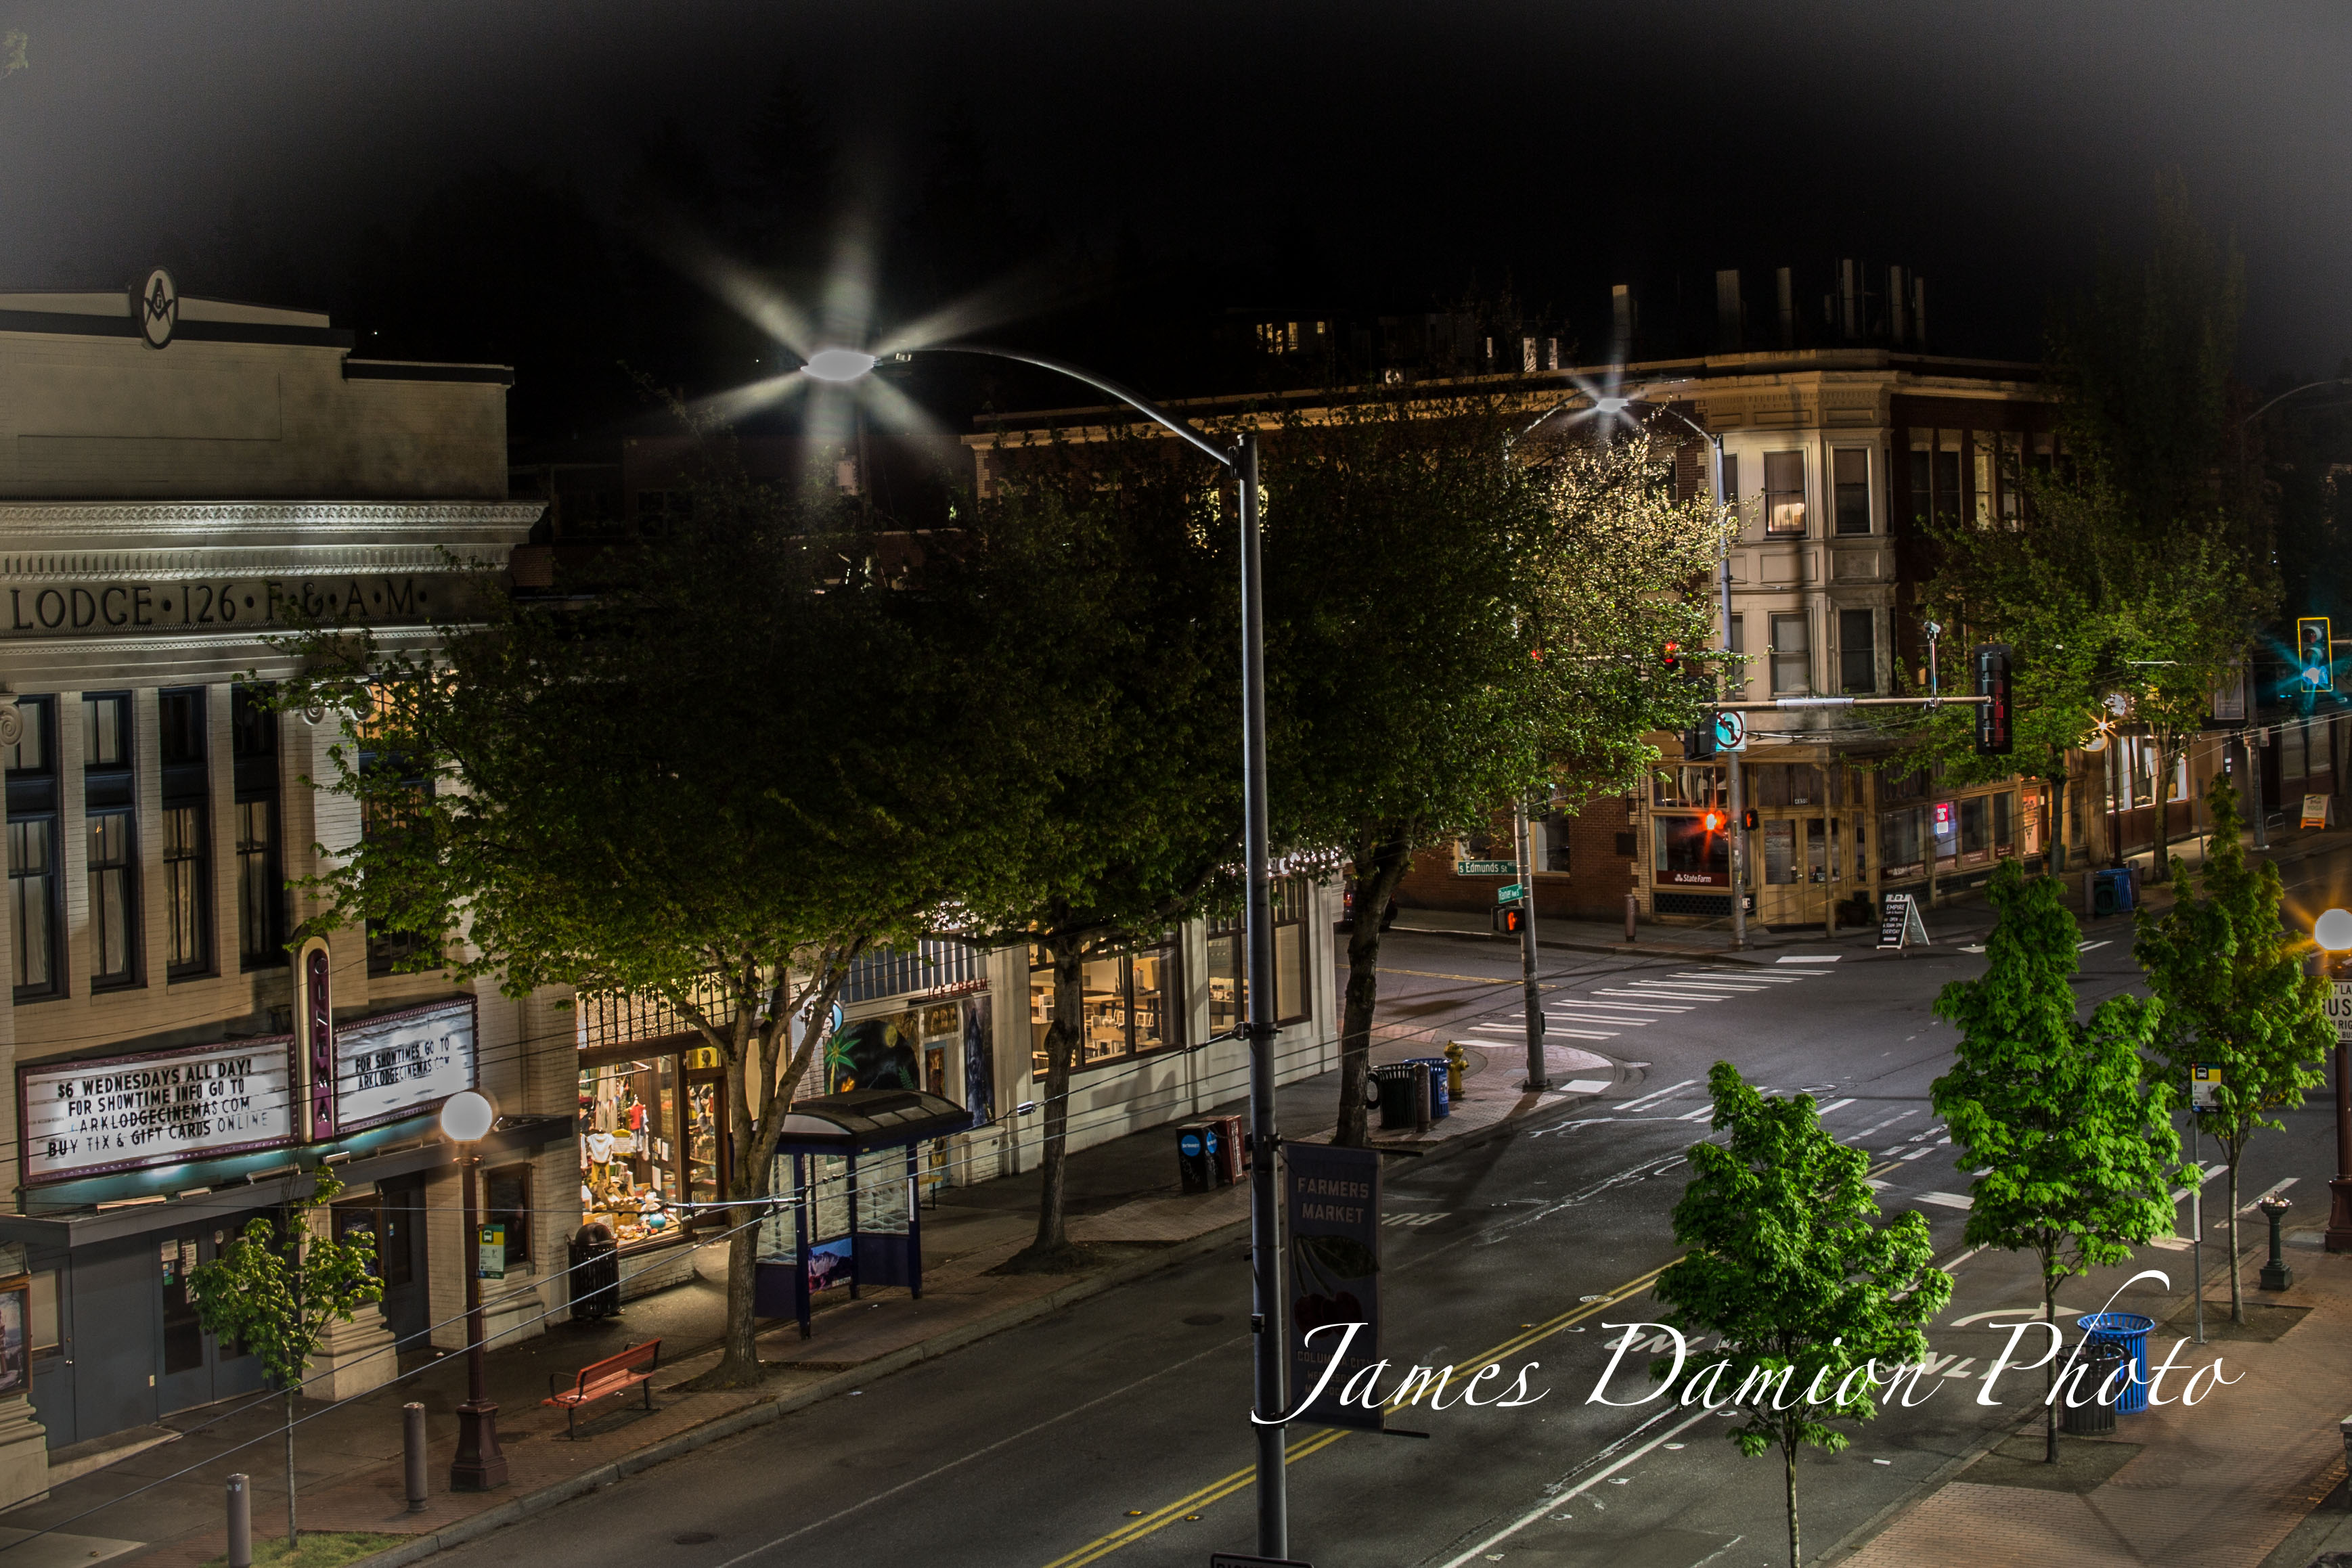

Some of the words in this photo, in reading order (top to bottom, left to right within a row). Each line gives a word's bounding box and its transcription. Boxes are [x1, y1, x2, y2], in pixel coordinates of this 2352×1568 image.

[10, 586, 152, 630] LODGE
[181, 584, 236, 624] 126
[1465, 862, 1499, 873] Edmunds
[928, 985, 946, 999] ICE
[950, 977, 988, 996] CREAM
[355, 1056, 372, 1073] FOR
[376, 1044, 420, 1068] SHOWTIMES
[425, 1041, 434, 1055] GO
[440, 1037, 449, 1052] TO
[58, 1082, 74, 1098] $6
[83, 1068, 180, 1096] WEDNESDAYS
[186, 1065, 212, 1082] ALL
[218, 1058, 252, 1077] DAY!
[68, 1100, 92, 1117] FOR
[98, 1088, 170, 1112] SHOWTIME
[176, 1084, 202, 1102] INFO
[209, 1081, 224, 1097] GO
[231, 1078, 244, 1094] TO
[48, 1139, 78, 1158] BUY
[87, 1135, 110, 1151] TIX
[116, 1134, 125, 1148] &
[131, 1126, 162, 1145] GIFT
[169, 1120, 211, 1139] CARDS
[217, 1112, 268, 1133] ONLINE
[1297, 1176, 1369, 1199] FARMERS
[1302, 1202, 1364, 1224] MARKET
